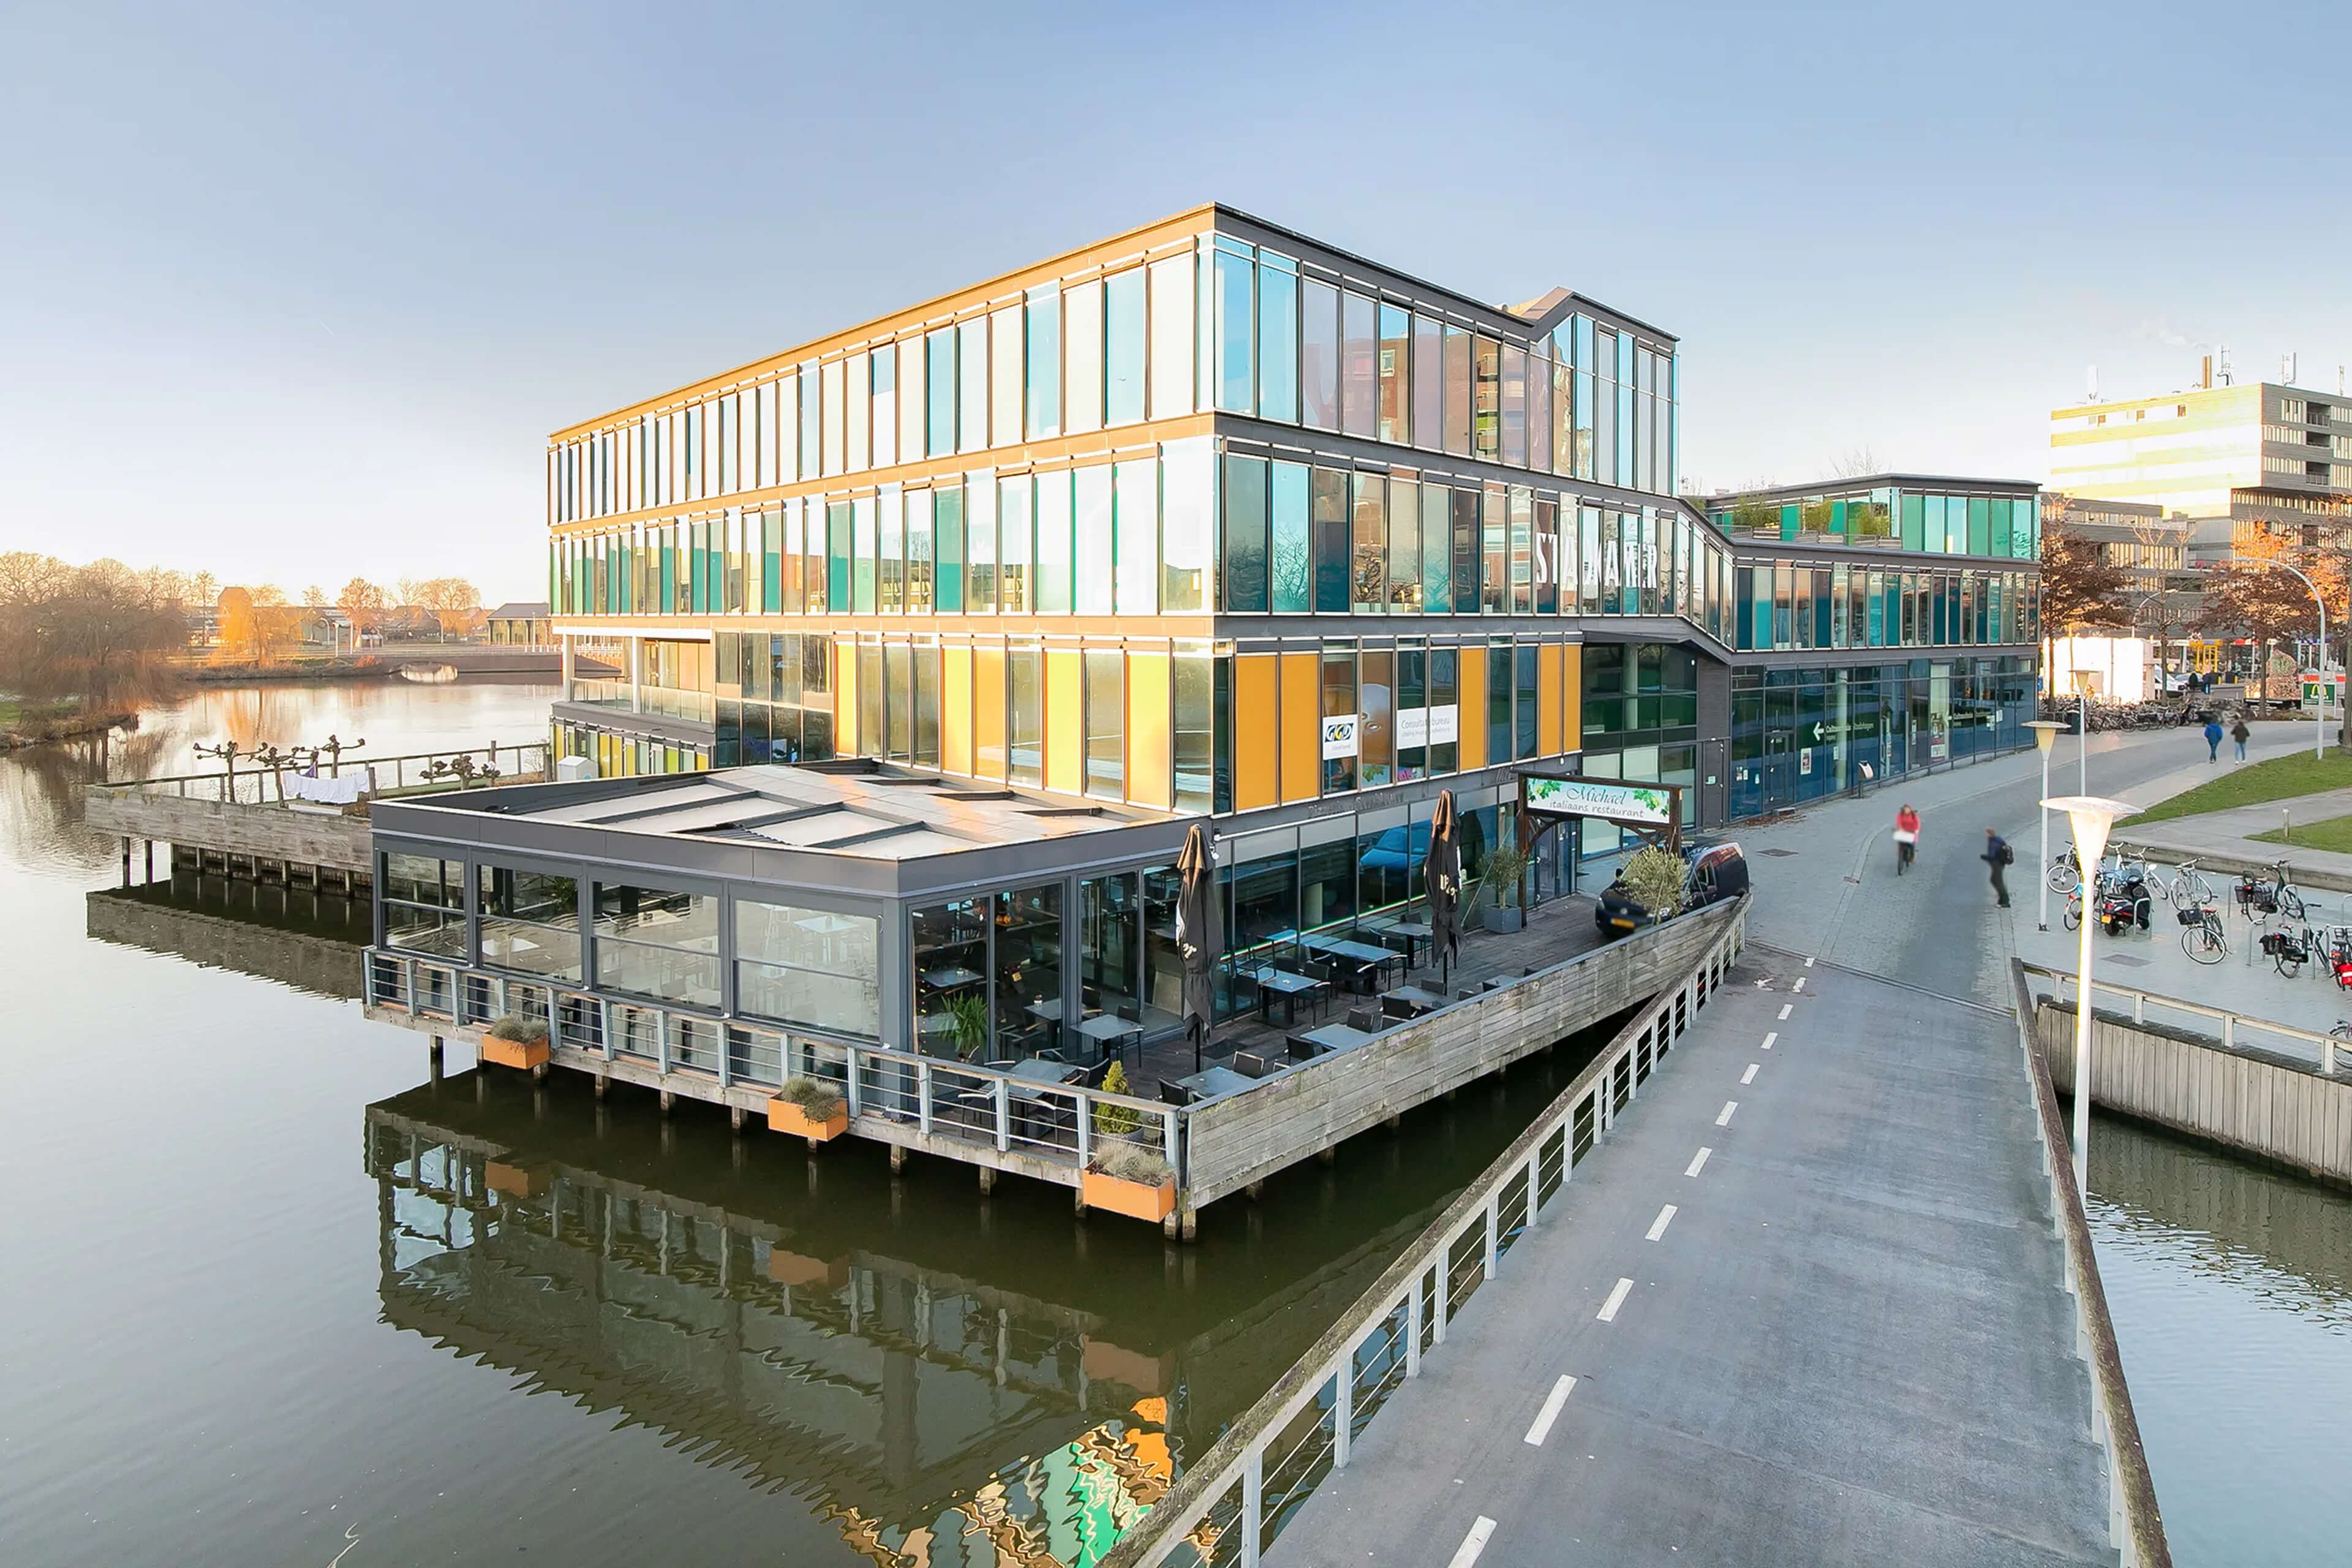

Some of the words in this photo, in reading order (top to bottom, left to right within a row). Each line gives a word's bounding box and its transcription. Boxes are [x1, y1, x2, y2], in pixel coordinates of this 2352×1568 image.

[1325, 723, 1354, 742] GGD
[1567, 786, 1627, 805] Michael
[1550, 799, 1588, 812] italiaans
[1593, 805, 1645, 818] restaurant
